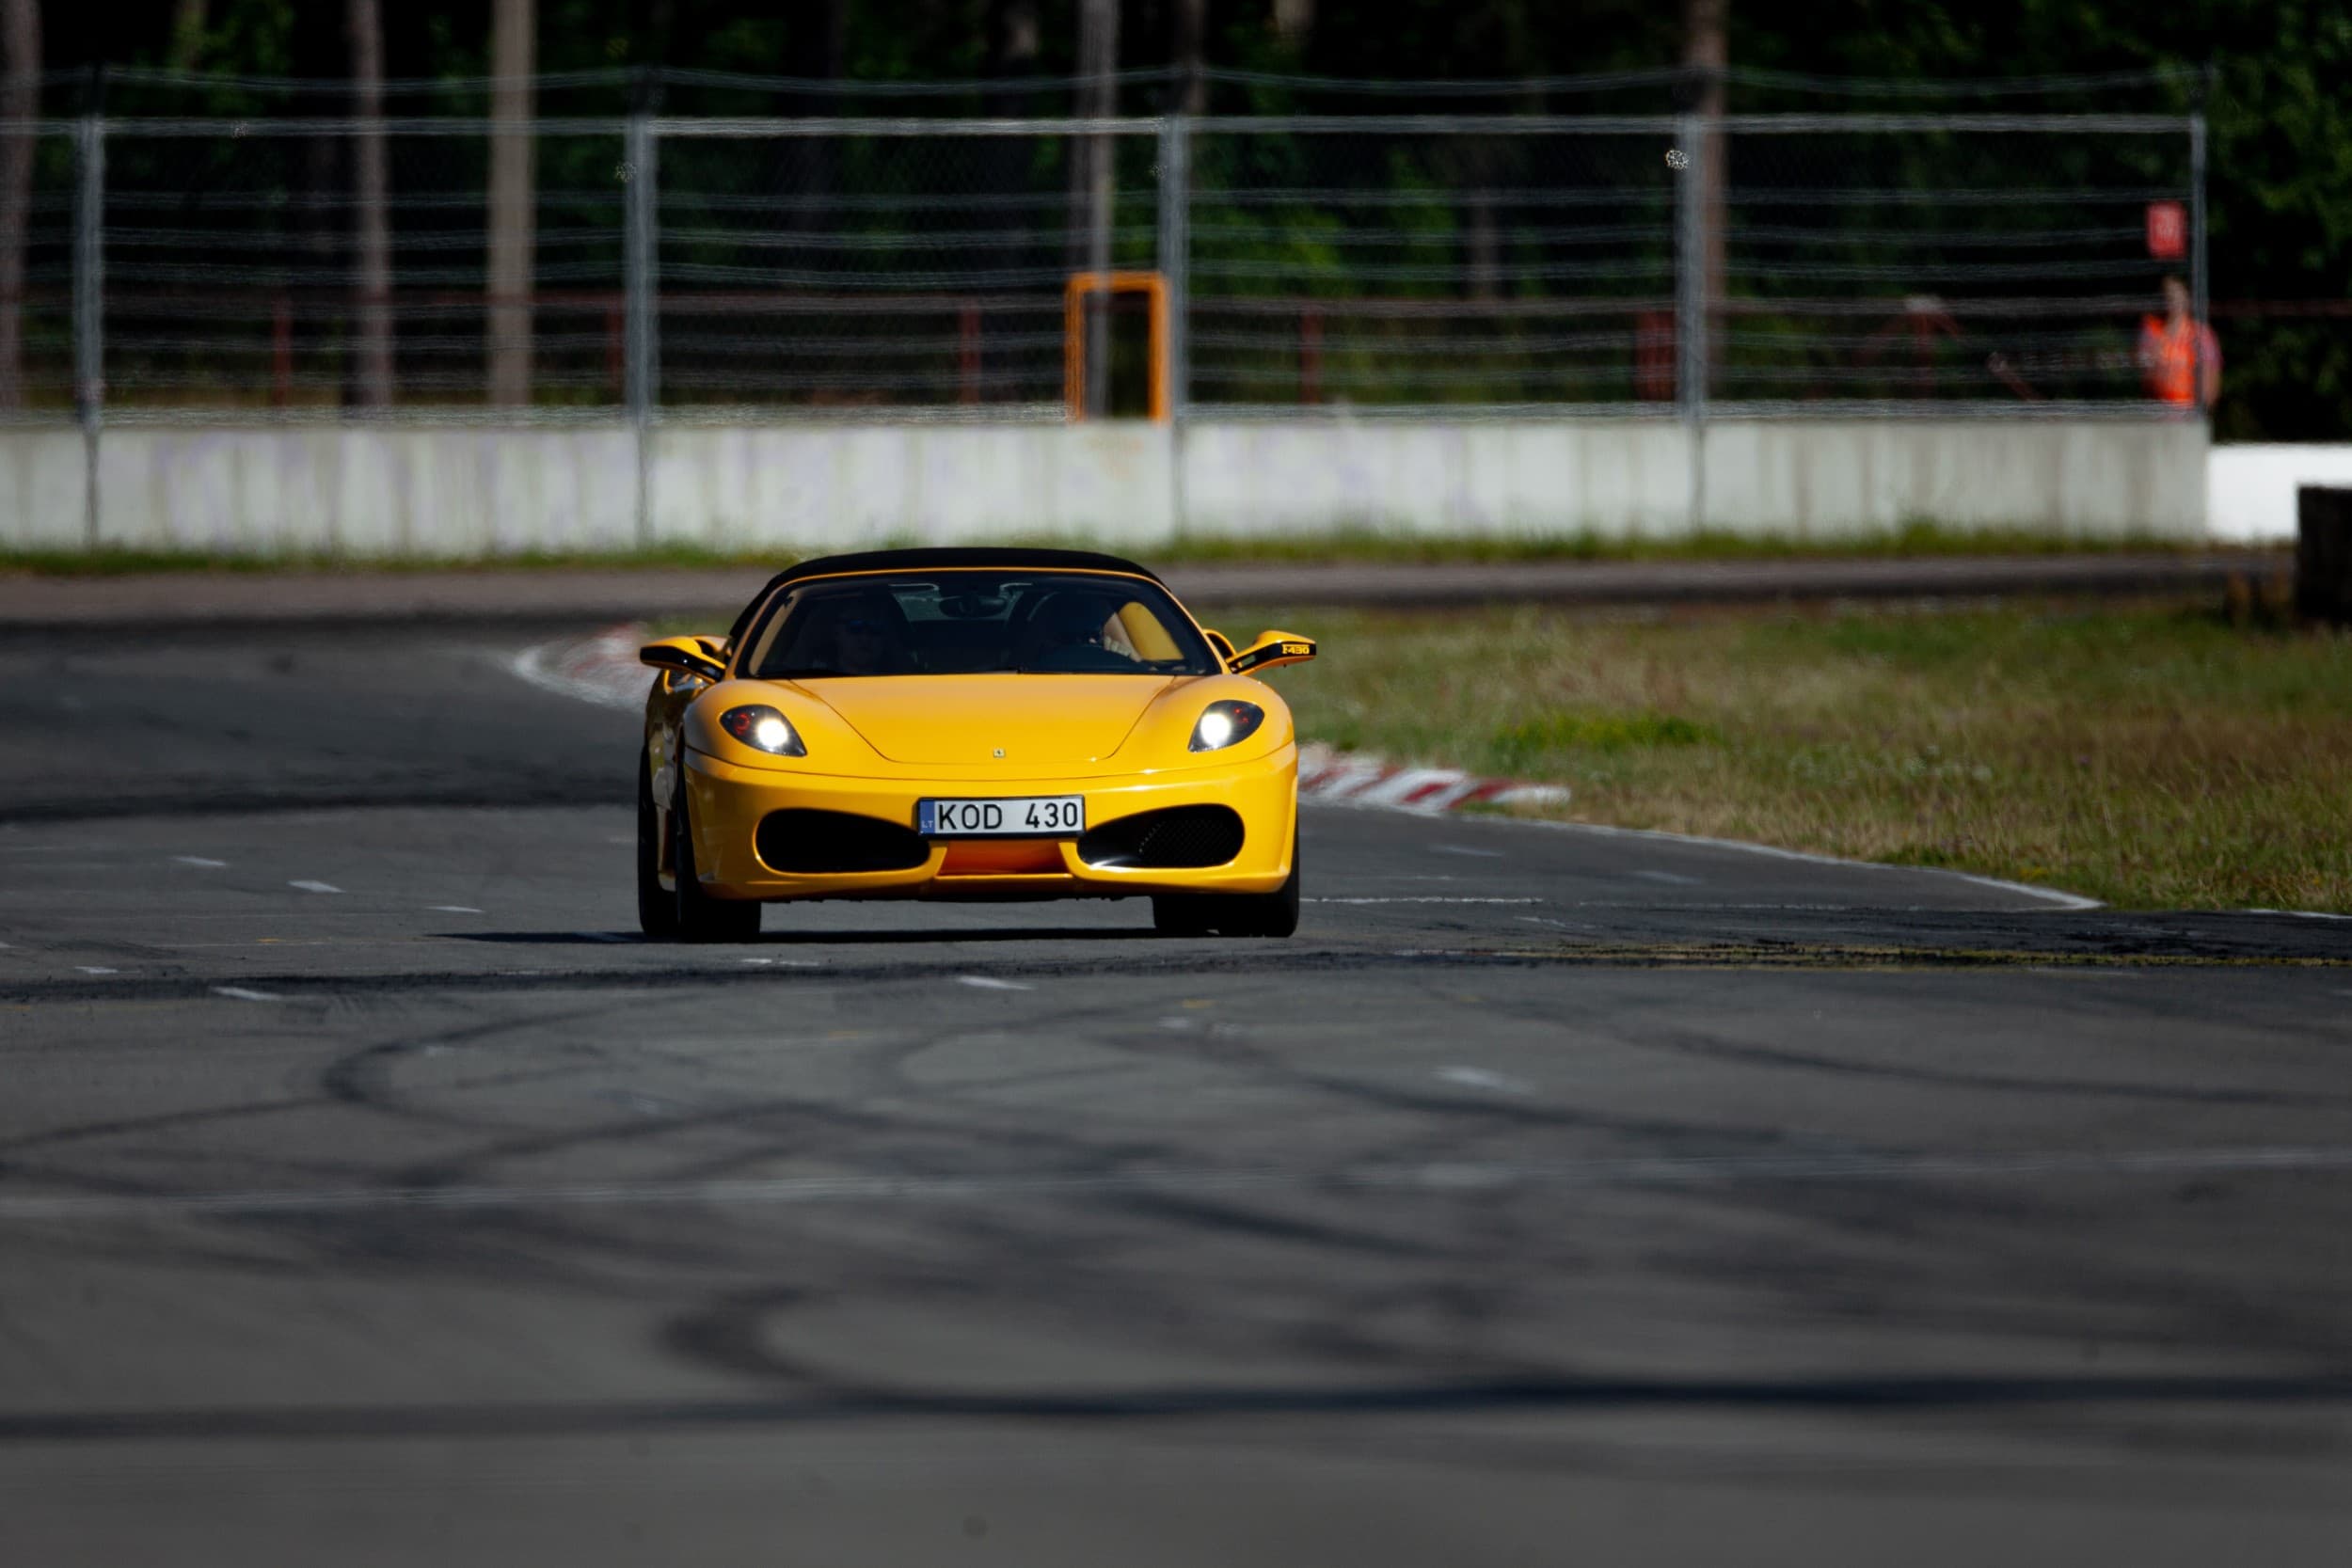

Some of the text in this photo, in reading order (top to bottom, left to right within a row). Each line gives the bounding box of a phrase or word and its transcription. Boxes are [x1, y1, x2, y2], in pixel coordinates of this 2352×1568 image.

[921, 820, 934, 829] LT
[939, 802, 1078, 830] KOD 430
